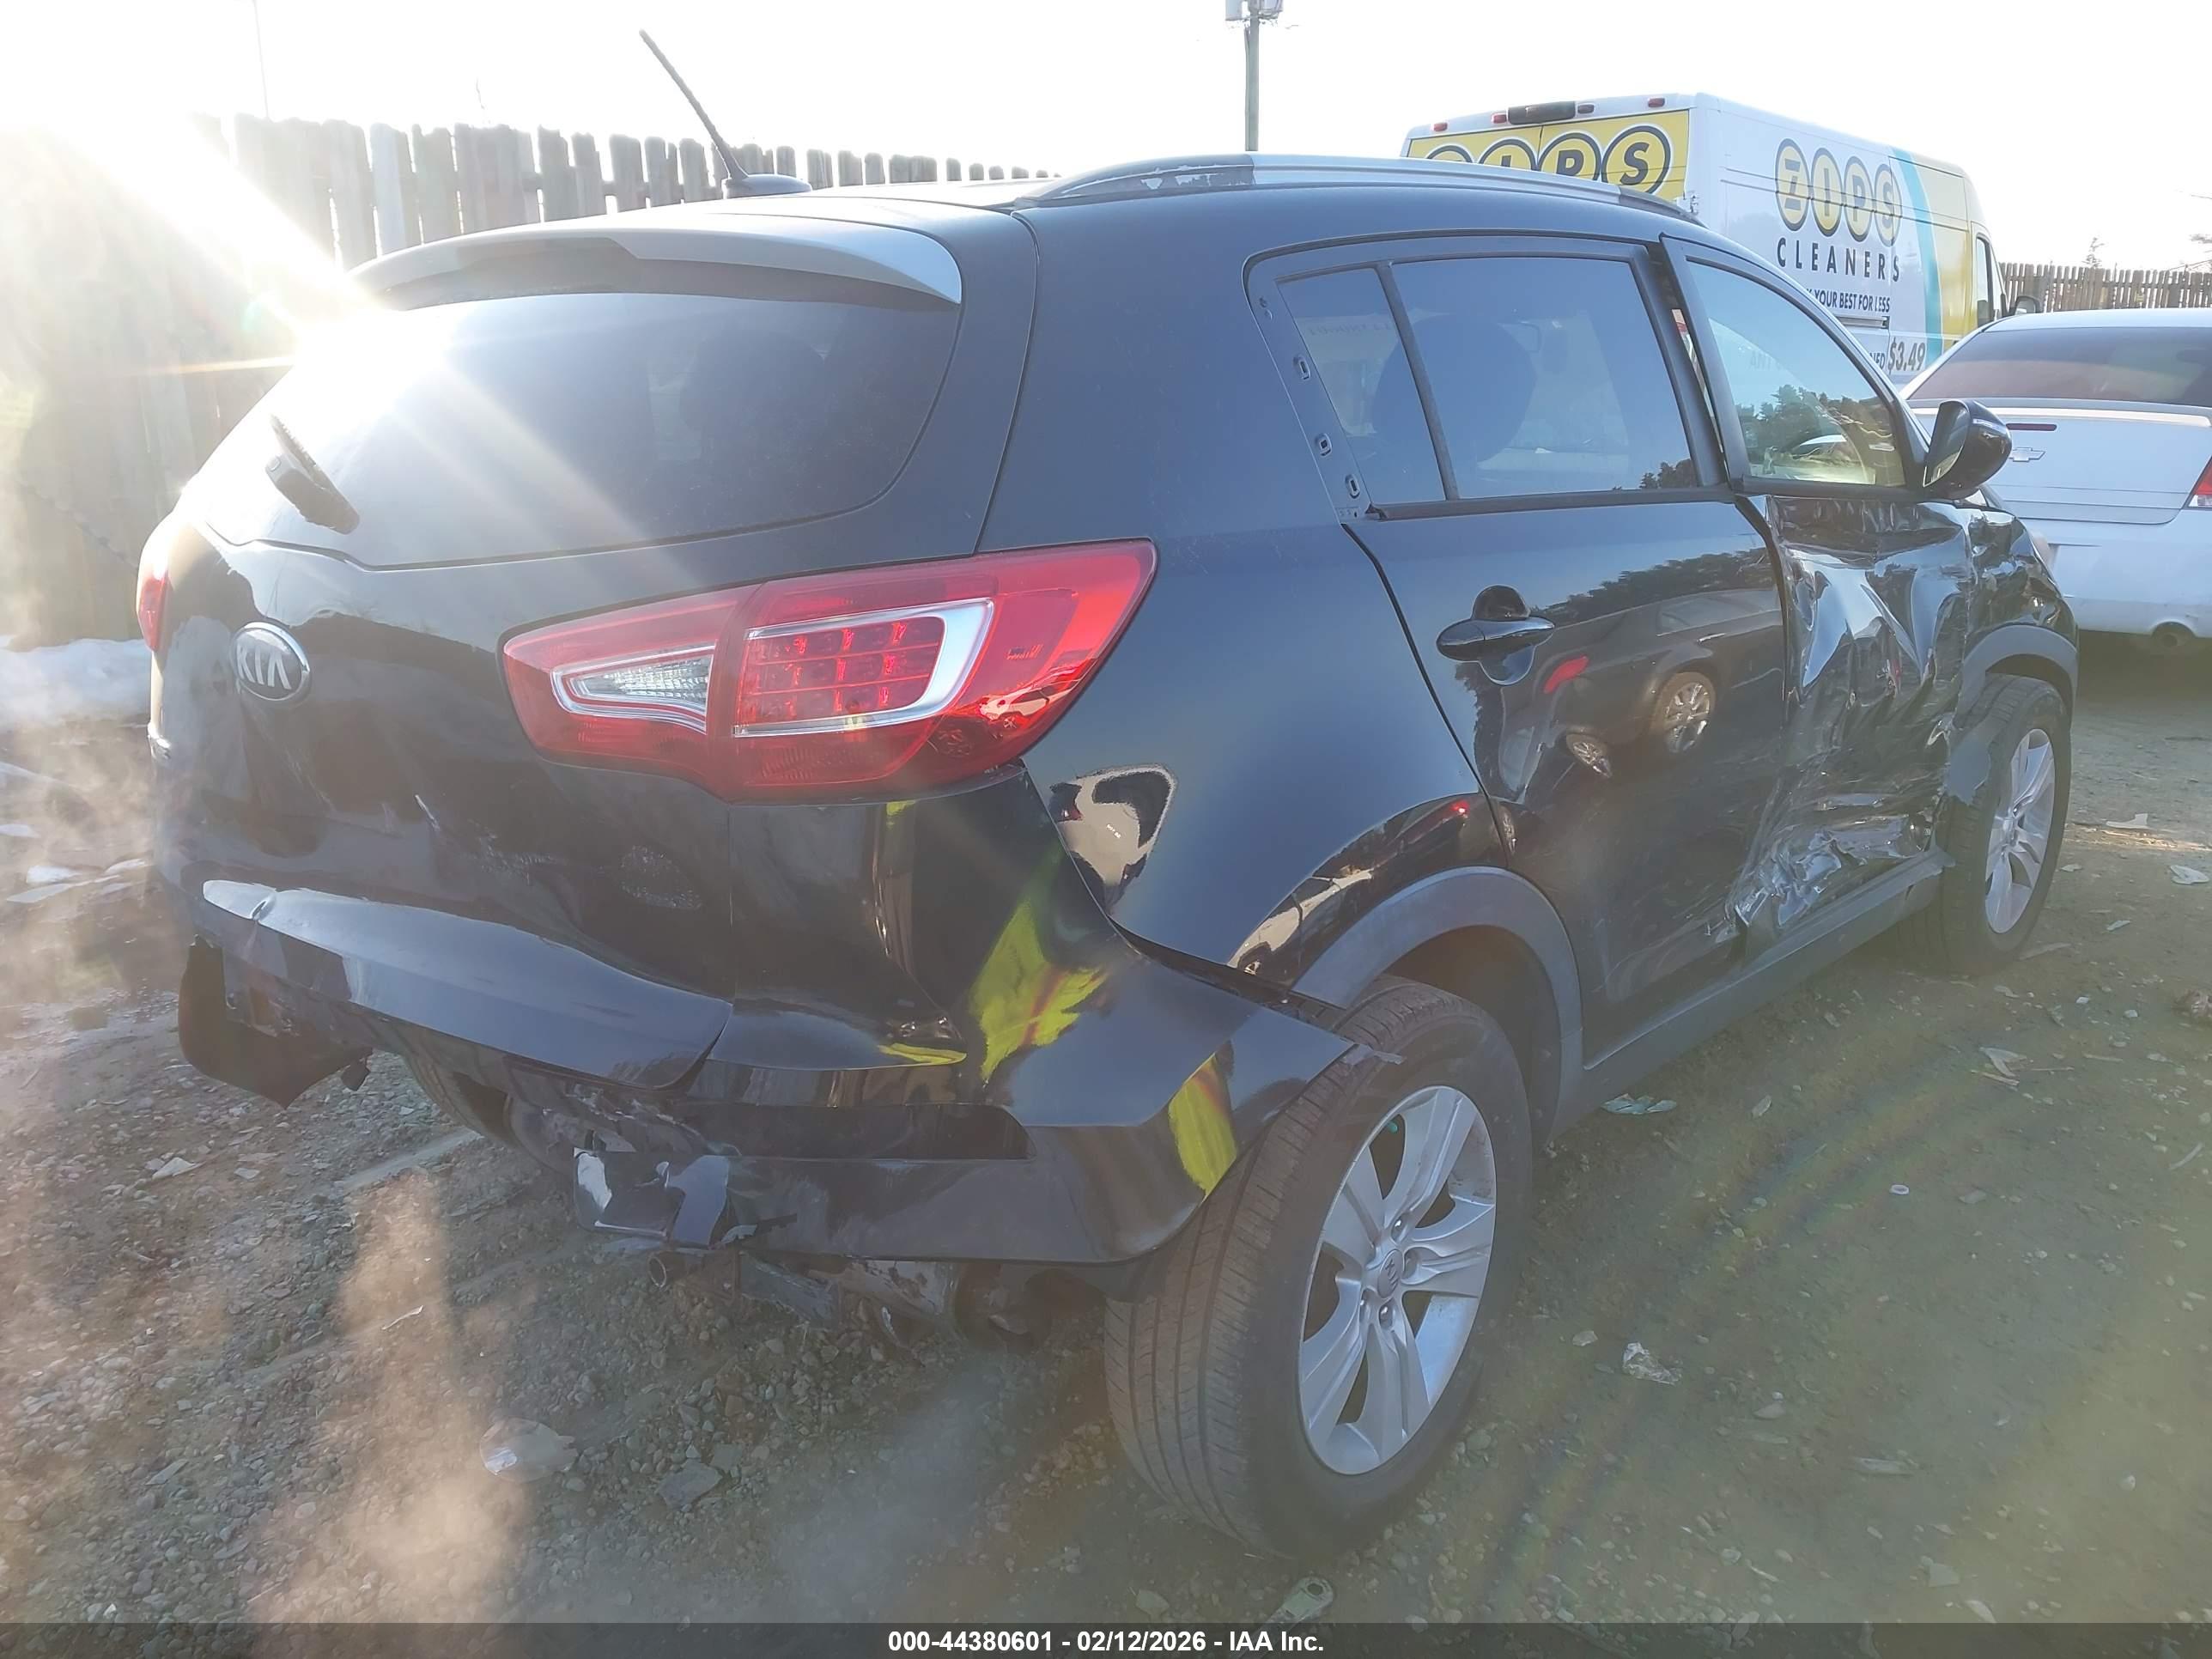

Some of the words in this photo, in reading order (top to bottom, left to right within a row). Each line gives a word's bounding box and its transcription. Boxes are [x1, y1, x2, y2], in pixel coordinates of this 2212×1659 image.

[1782, 155, 1896, 225] ZIPS
[1777, 237, 1899, 283] CLEANERS
[1814, 289, 1838, 308] YOUR
[1839, 292, 1857, 310] BEST
[1858, 295, 1873, 312] FOR
[1875, 296, 1890, 313] LESS
[1888, 337, 1925, 375] $3.49
[236, 641, 292, 690] KIA
